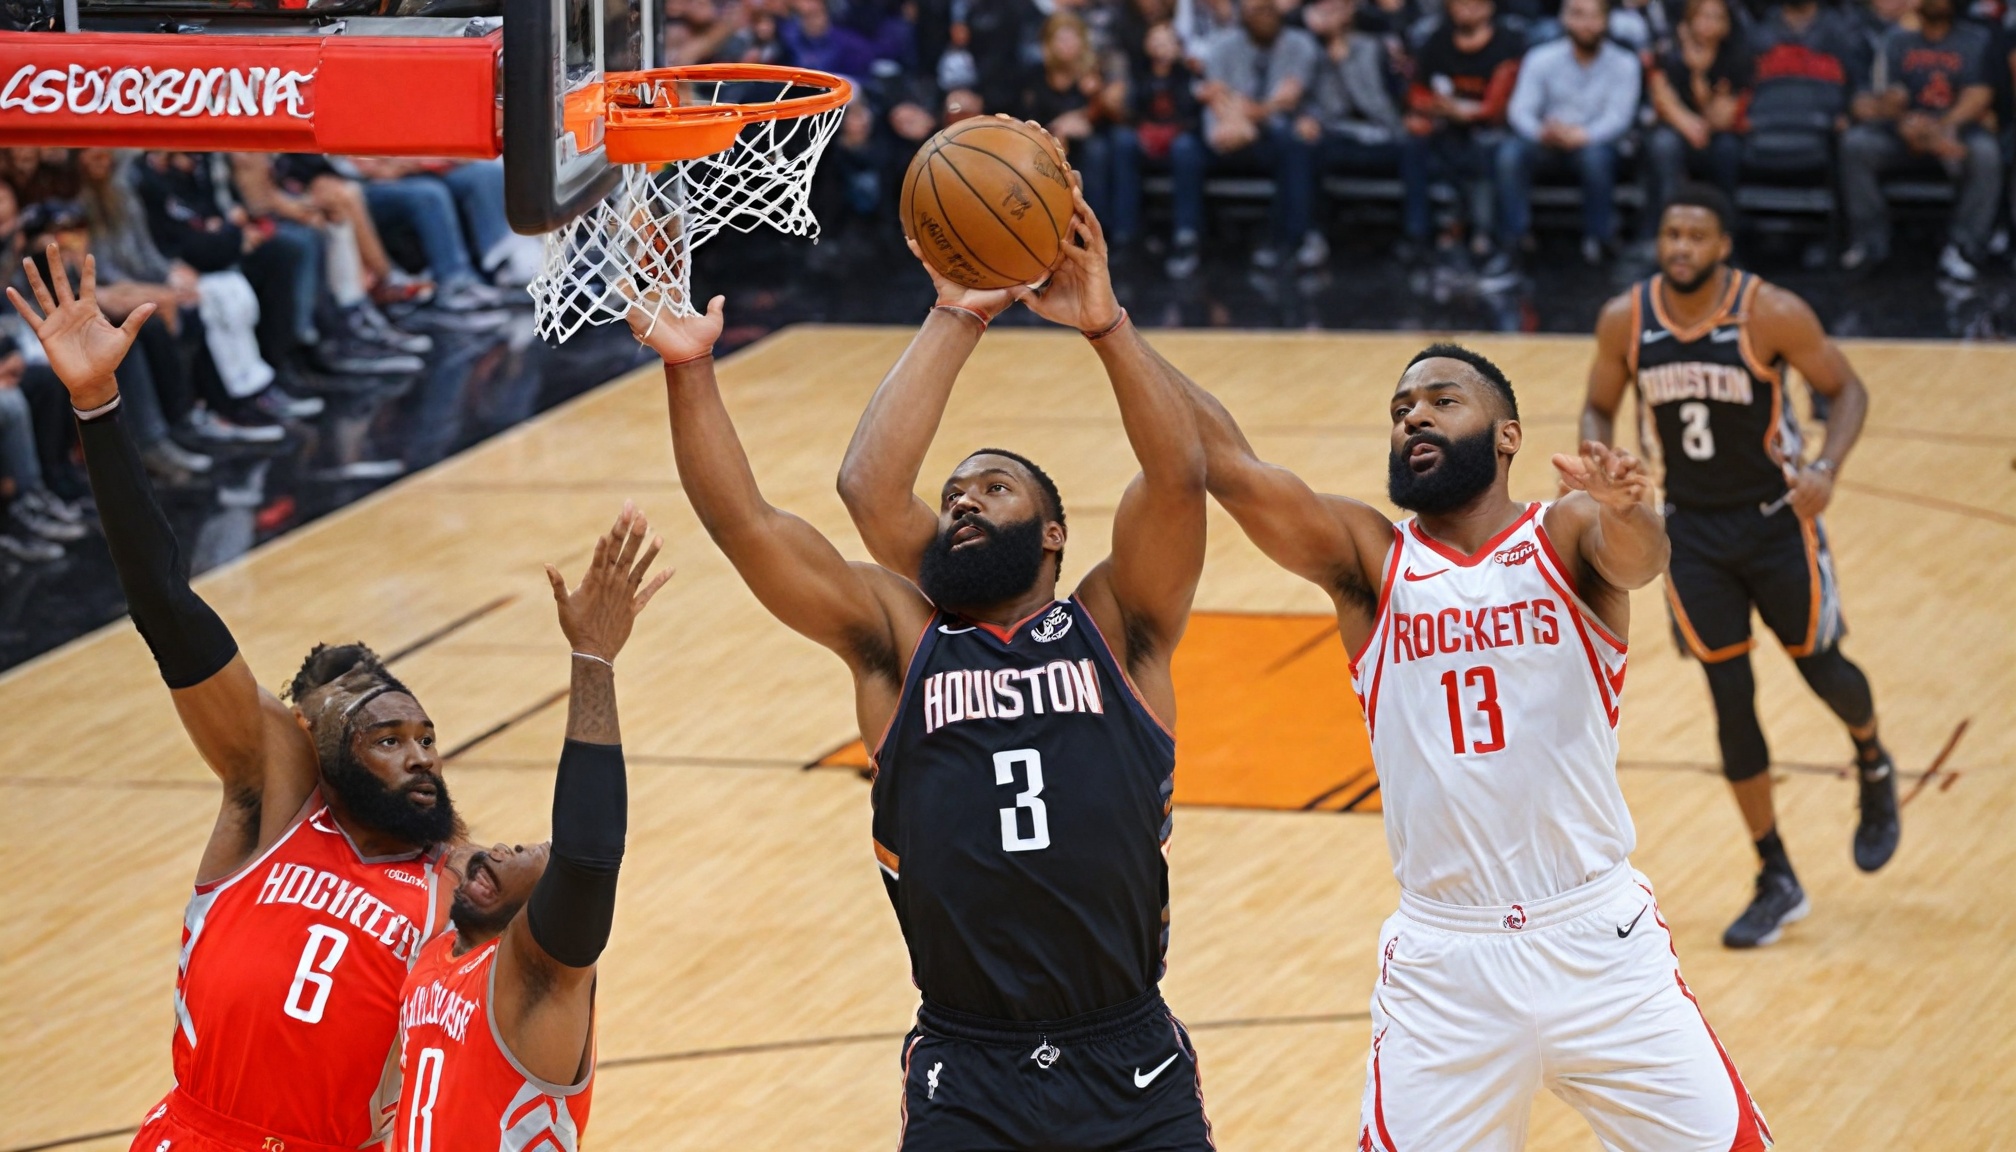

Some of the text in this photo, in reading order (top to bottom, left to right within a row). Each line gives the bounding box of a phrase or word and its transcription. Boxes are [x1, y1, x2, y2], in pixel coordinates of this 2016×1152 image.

[1440, 665, 1506, 754] 13
[992, 747, 1051, 852] 3
[283, 923, 349, 1024] 6
